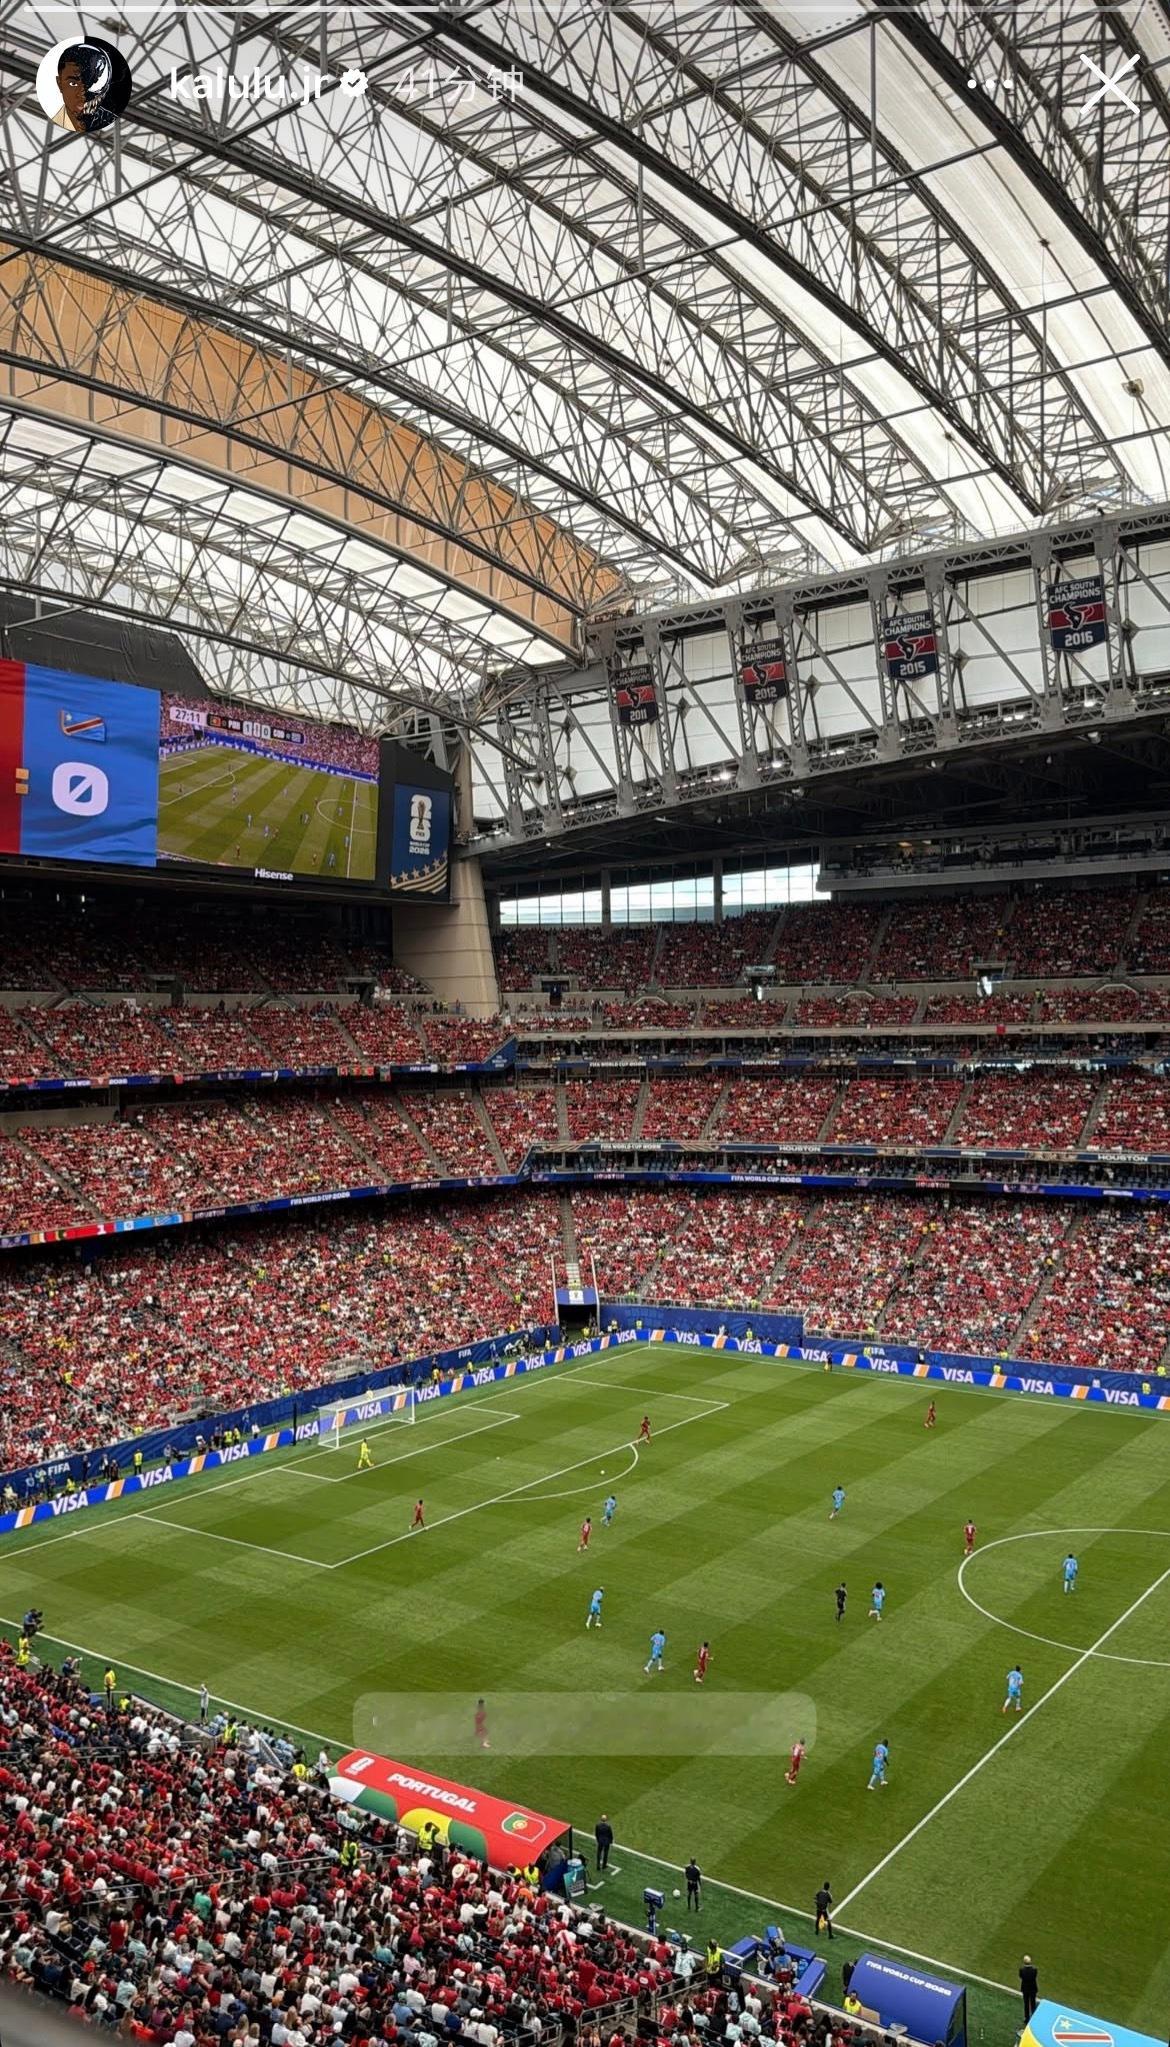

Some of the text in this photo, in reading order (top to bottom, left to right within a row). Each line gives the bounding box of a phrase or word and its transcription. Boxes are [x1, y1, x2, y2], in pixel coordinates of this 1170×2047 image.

[1055, 581, 1095, 594] AFC SOUTH
[1049, 587, 1101, 604] CHAMPIONS
[885, 620, 931, 636] CHAMPIONS
[890, 615, 926, 627] AFC SOUTH
[1065, 631, 1094, 647] 2016
[742, 649, 781, 662] CHAMPIONS
[900, 661, 926, 676] 2015
[755, 686, 778, 701] 2012
[175, 709, 200, 722] 27:11
[630, 709, 647, 721] 2011
[52, 762, 109, 817] 0
[255, 868, 294, 880] Hisense
[1098, 1154, 1148, 1162] HOUSTON
[290, 1198, 302, 1206] FIFA
[616, 1329, 637, 1344] VISA
[675, 1331, 700, 1346] VISA
[458, 1349, 471, 1358] FIFA
[572, 1342, 592, 1357] VISA
[736, 1338, 762, 1354] VISA
[800, 1347, 828, 1362] VISA
[525, 1354, 545, 1371] VISA
[870, 1358, 899, 1373] VISA
[472, 1369, 495, 1386] VISA
[941, 1367, 974, 1384] VISA
[415, 1384, 440, 1402] VISA
[1020, 1378, 1054, 1395] VISA
[1102, 1388, 1140, 1406] VISA
[356, 1401, 382, 1420] VISA
[218, 1442, 250, 1464] VISA
[48, 1462, 71, 1476] FIFA
[137, 1465, 173, 1488] VISA
[48, 1491, 88, 1516] VISA
[387, 1773, 477, 1813] PORTUGAL
[866, 1960, 952, 1996] FIFA WORLD CUP 2026
